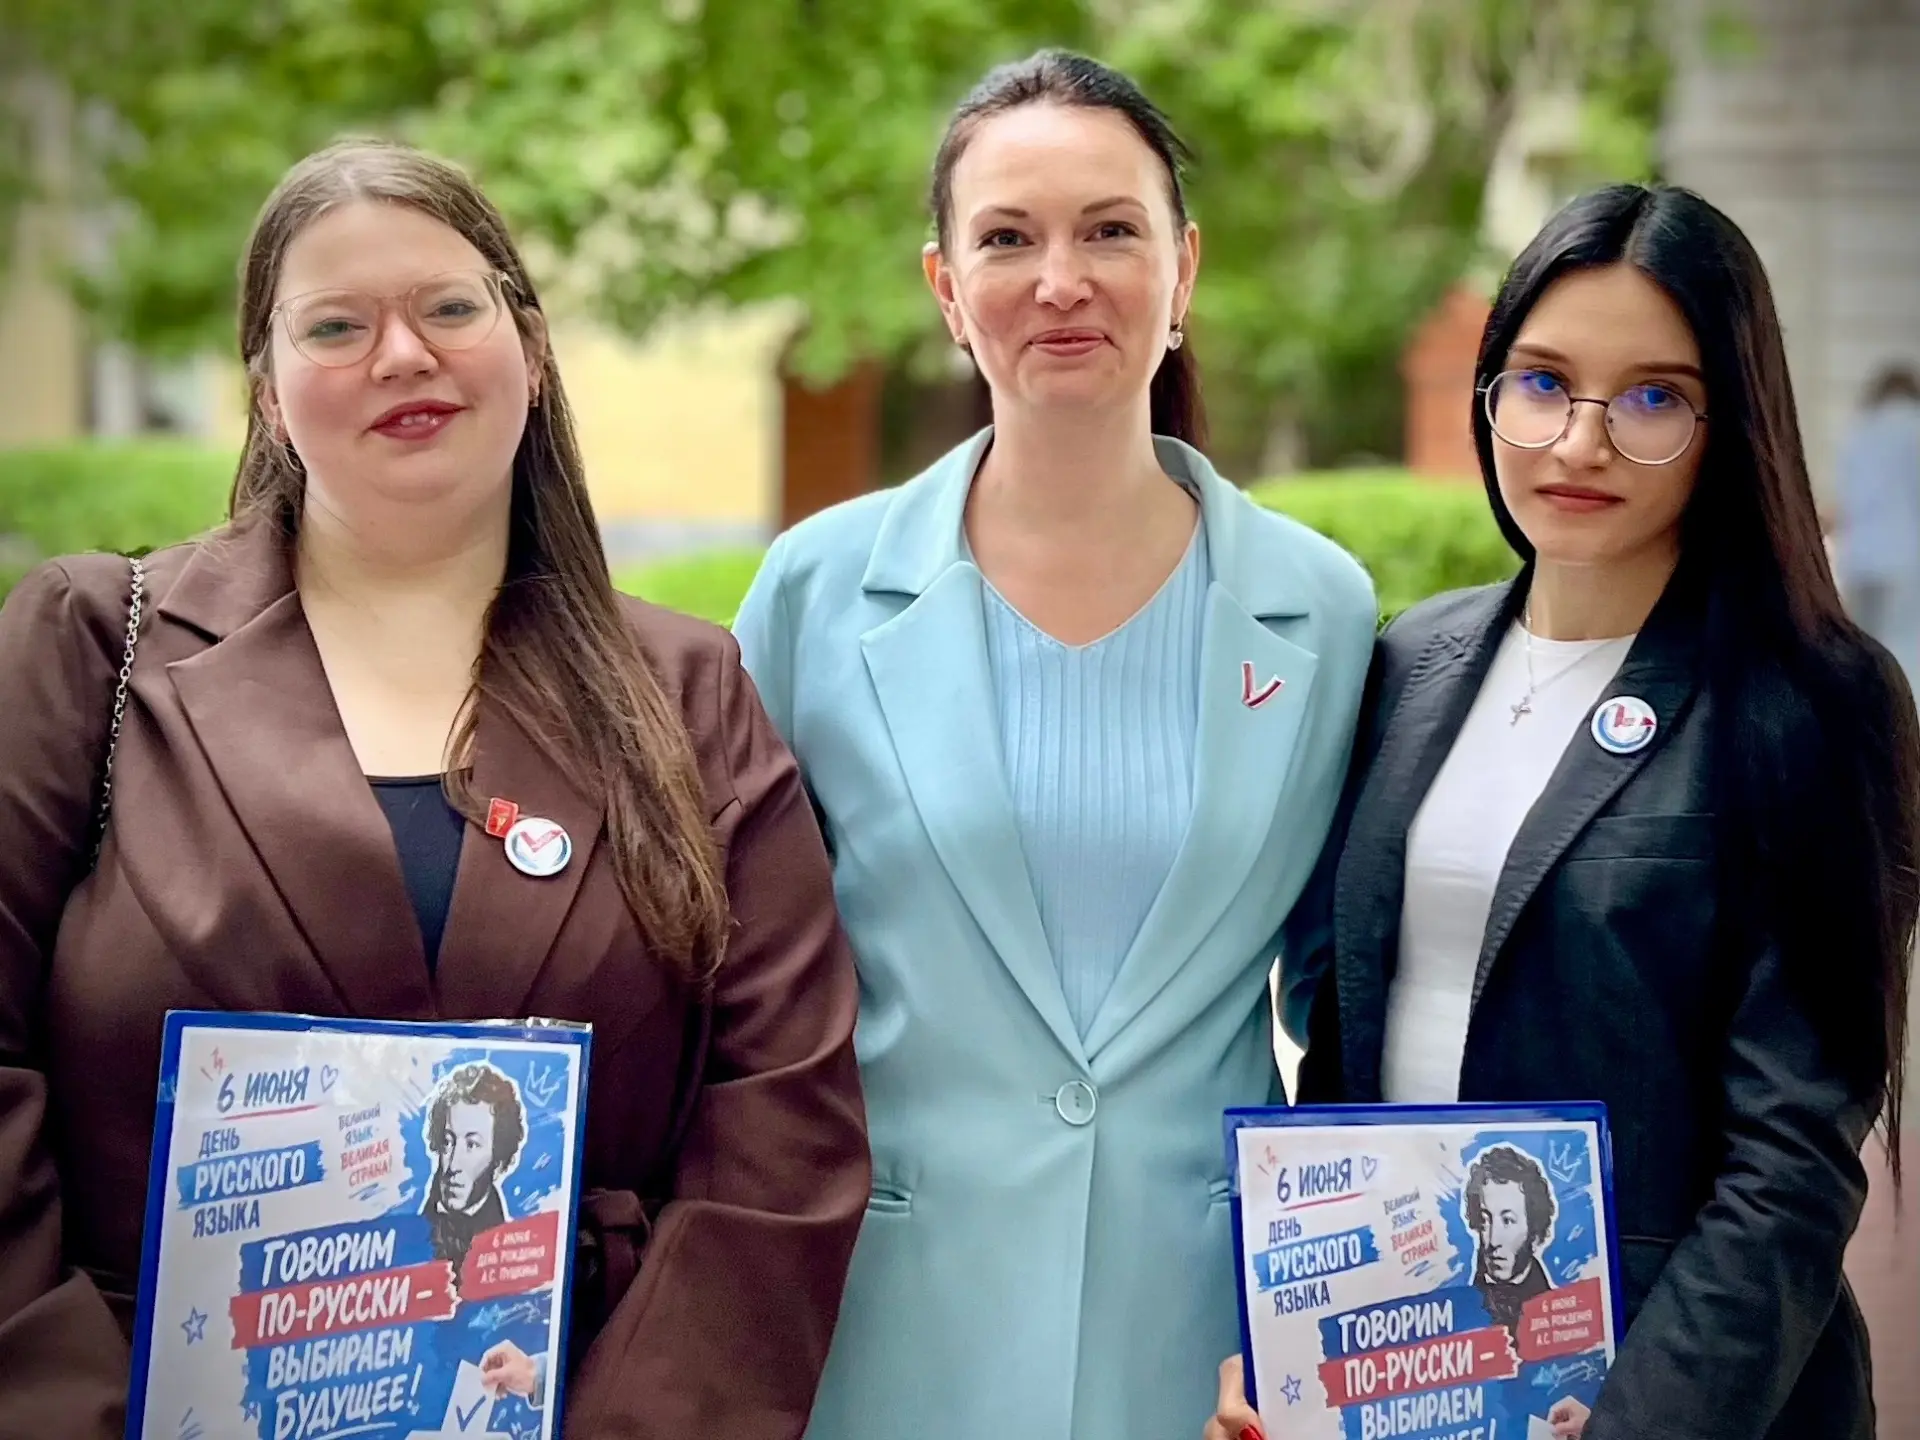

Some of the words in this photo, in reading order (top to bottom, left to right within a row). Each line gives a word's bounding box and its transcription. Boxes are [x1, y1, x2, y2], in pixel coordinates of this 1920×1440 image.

[217, 1073, 235, 1114] 6
[243, 1065, 311, 1108] ИЮНЯ
[338, 1101, 381, 1131] ВЕЛИКИЙ
[198, 1128, 240, 1158] ДЕНЬ
[341, 1138, 389, 1171] ВЕЛИКАЯ
[194, 1149, 306, 1200] РУССКОГО
[349, 1154, 392, 1188] СТРАНА!
[1277, 1167, 1292, 1204] 6
[1298, 1157, 1352, 1198] ИЮНЯ
[192, 1200, 260, 1239] ЯЗЫКА
[1383, 1185, 1420, 1215] ВЕЛИКИЙ
[1268, 1216, 1302, 1247] ДЕНЬ
[1390, 1219, 1433, 1252] ВЕЛИКАЯ
[261, 1228, 396, 1287] ГОВОРИМ
[1268, 1233, 1362, 1284] РУССКОГО
[1274, 1280, 1331, 1317] ЯЗЫКА
[1337, 1299, 1453, 1354] ГОВОРИМ
[266, 1326, 414, 1391] ВЫБИРАЕМ
[273, 1362, 423, 1440] БУДУЩЕЕ!
[1360, 1385, 1484, 1440] ВЫБИРАЕМ
